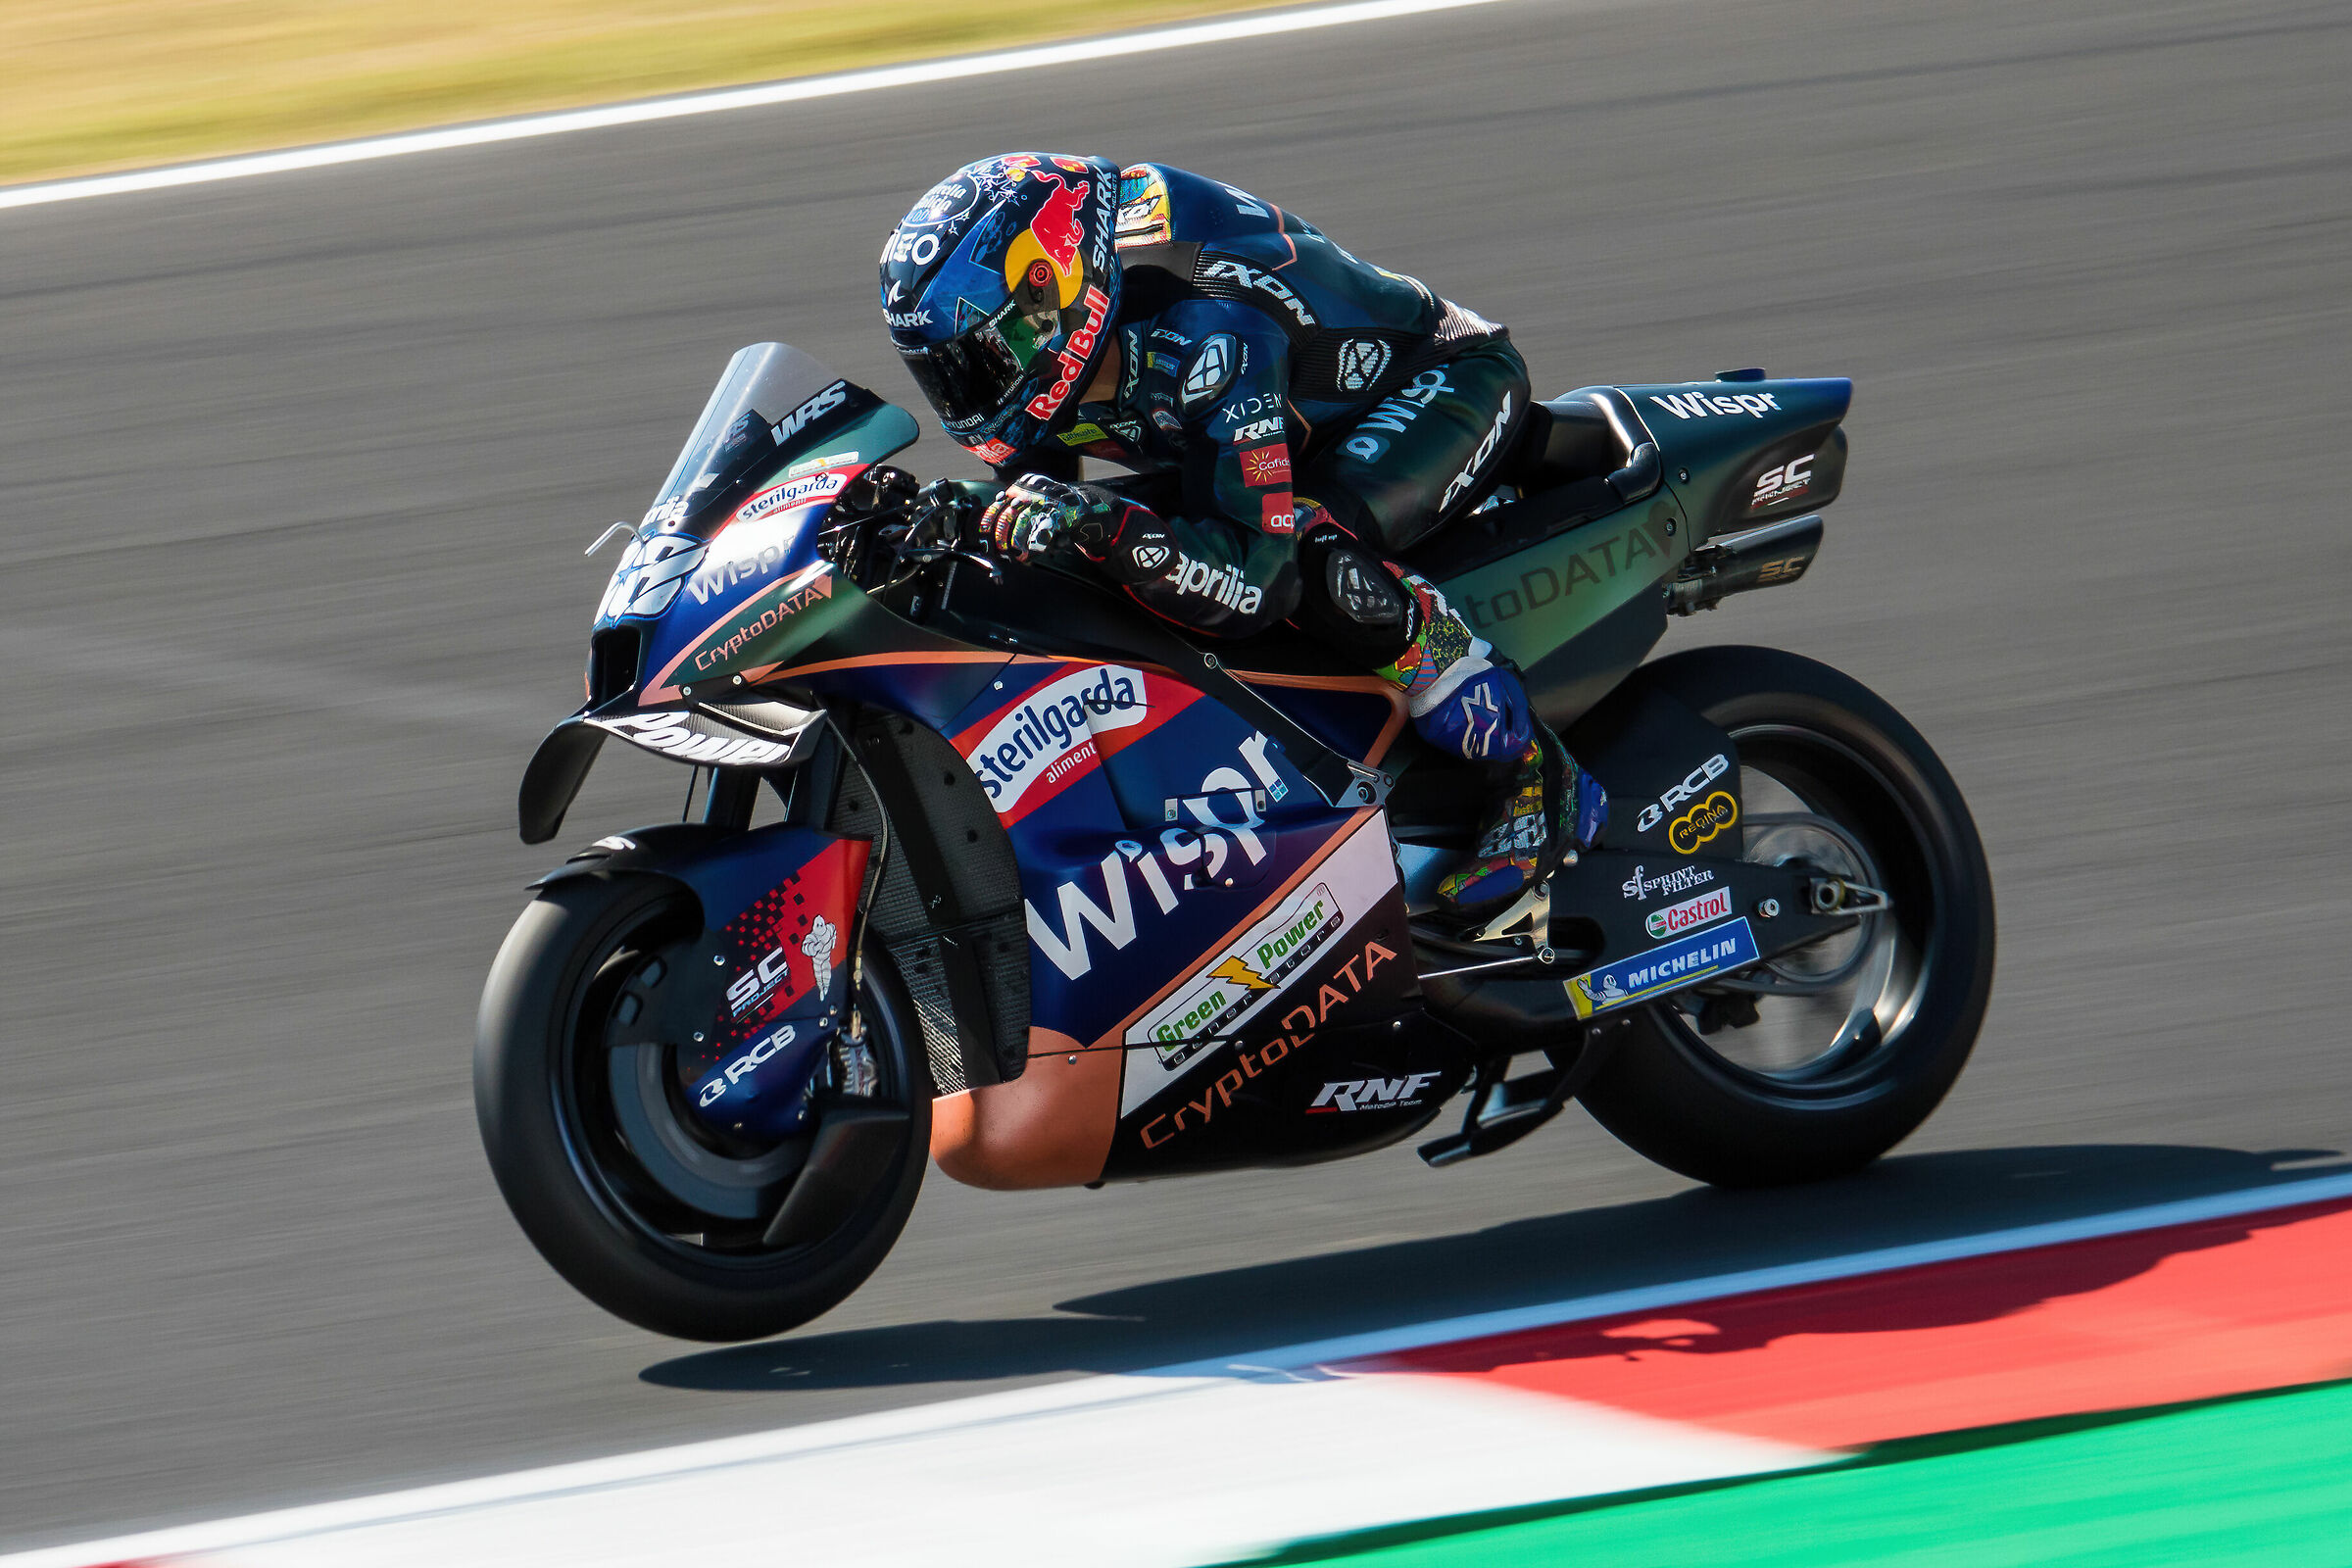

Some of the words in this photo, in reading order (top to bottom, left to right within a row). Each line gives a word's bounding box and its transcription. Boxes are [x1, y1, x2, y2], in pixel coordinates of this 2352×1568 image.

[1093, 164, 1112, 273] SHARK
[988, 299, 1016, 328] SHARK
[1203, 260, 1316, 326] IXON
[1025, 350, 1086, 421] Red
[1065, 283, 1110, 361] Bull
[770, 379, 848, 447] WRS
[1368, 364, 1456, 434] Wisp
[1651, 389, 1784, 419] Wispr
[742, 472, 839, 519] sterilgarda
[1753, 453, 1816, 498] SC
[686, 535, 798, 607] Wispr
[1165, 550, 1263, 615] aprilia
[1468, 525, 1658, 629] toDATA
[694, 574, 833, 672] CryptoDATA
[974, 666, 1137, 800] sterilgarda
[1660, 754, 1729, 812] RCB
[1025, 731, 1290, 981] Wispr
[1643, 865, 1695, 892] SPRINT
[1662, 869, 1714, 897] FILTER
[1668, 892, 1727, 931] Castrol
[726, 946, 788, 1011] SC
[1155, 990, 1227, 1052] Green
[1256, 900, 1324, 970] Power
[1628, 937, 1737, 989] MICHELIN
[724, 1024, 796, 1085] RCB
[1140, 940, 1396, 1151] CryptoDATA
[1310, 1070, 1442, 1112] RNF
